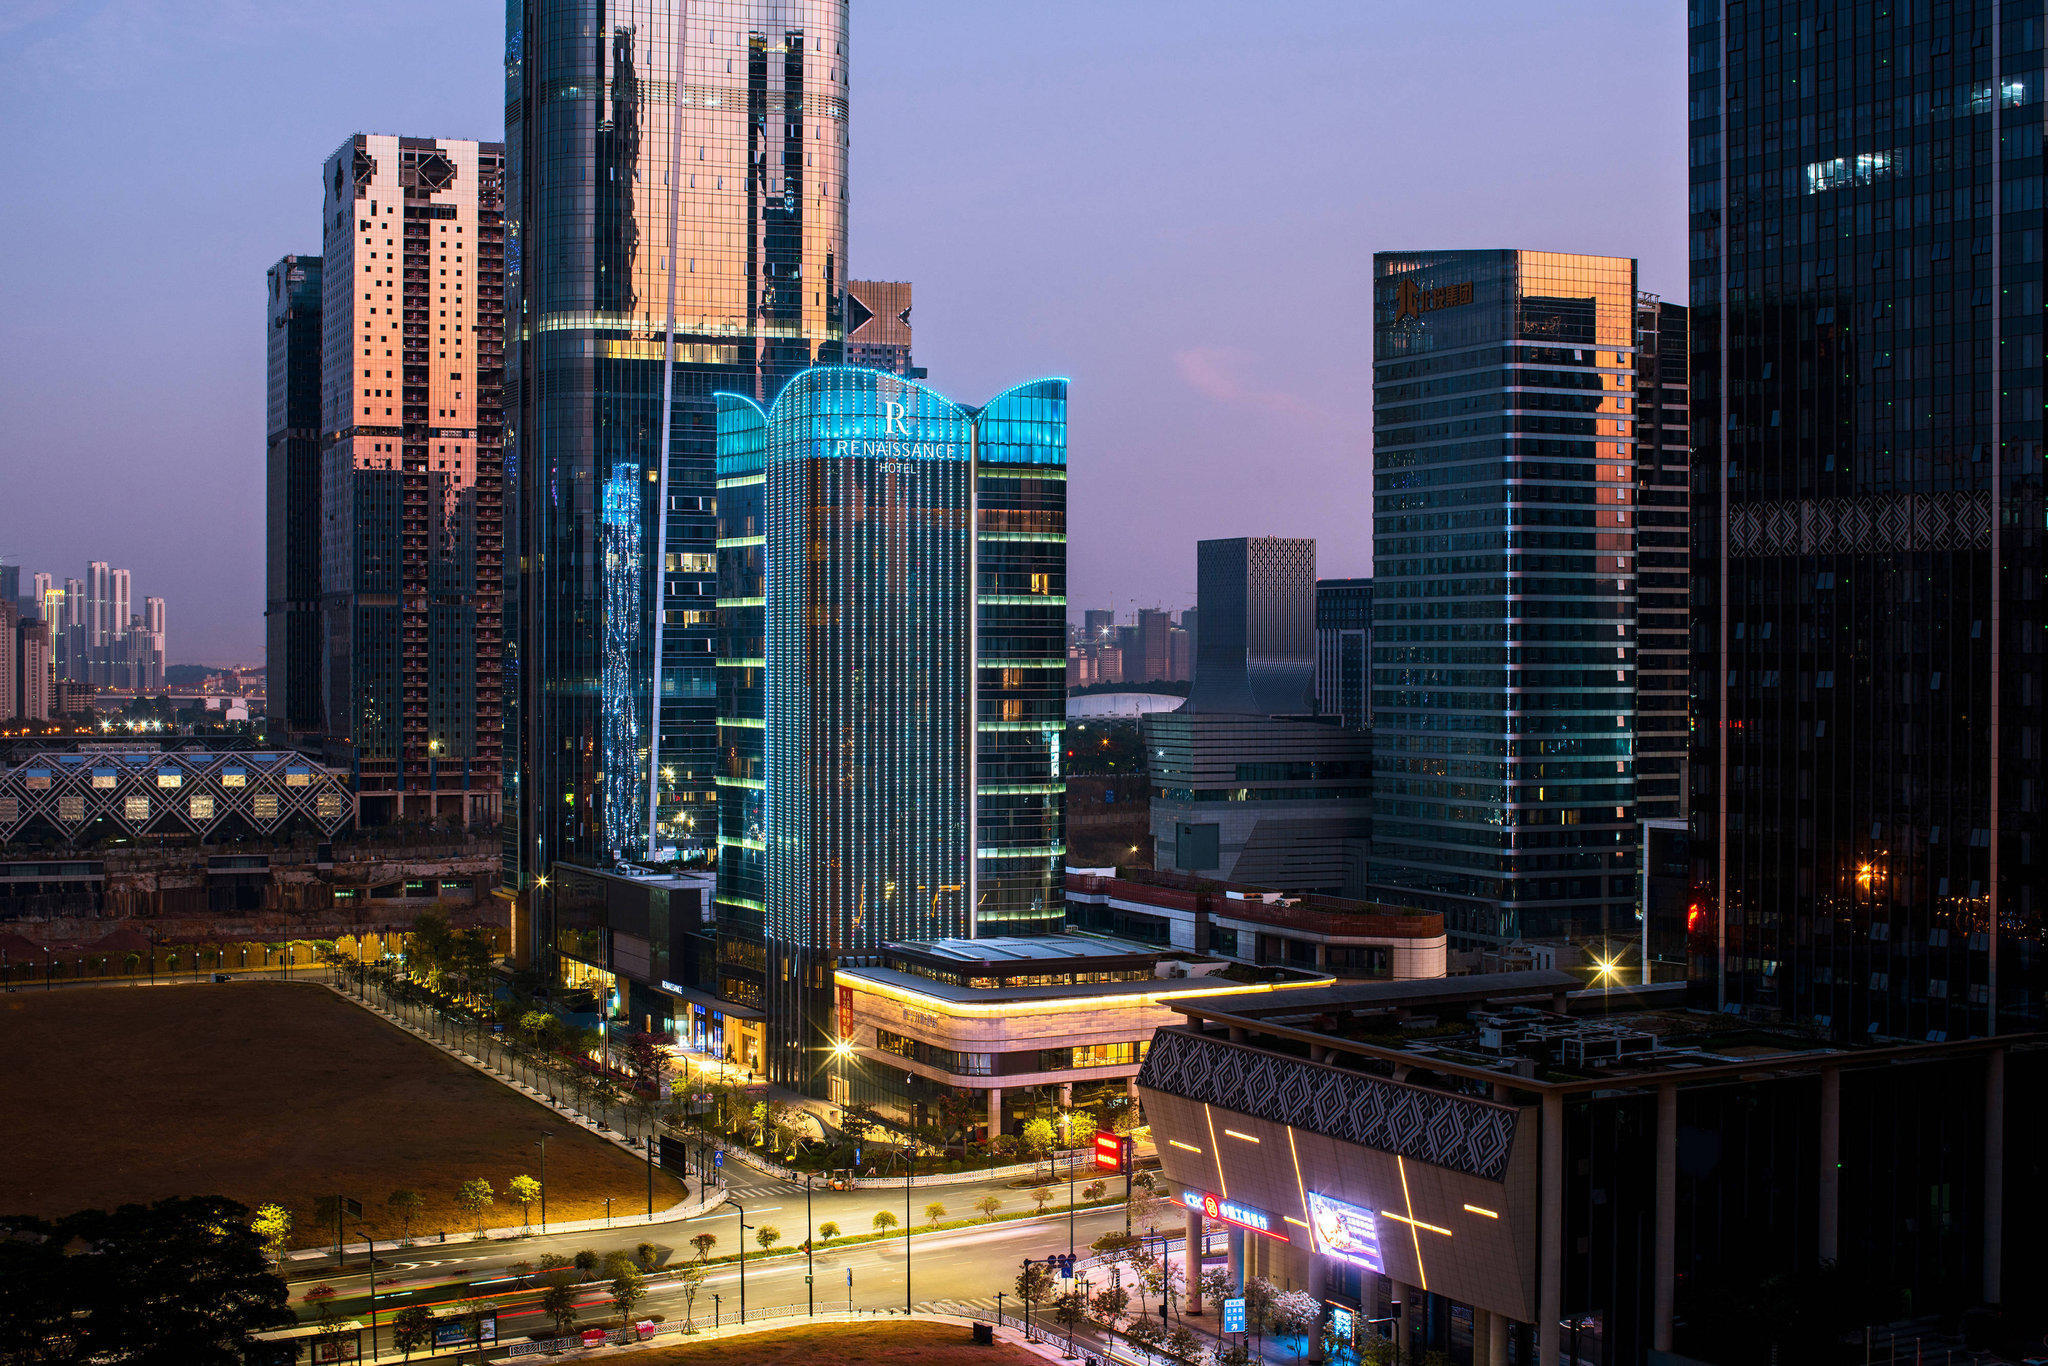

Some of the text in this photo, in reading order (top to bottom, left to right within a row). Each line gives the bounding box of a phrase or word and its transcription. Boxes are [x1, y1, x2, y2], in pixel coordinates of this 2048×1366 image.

[1419, 281, 1474, 313] 北投集团
[884, 400, 913, 435] R
[836, 440, 956, 459] RENAISSANCE
[879, 462, 917, 475] HOTEL
